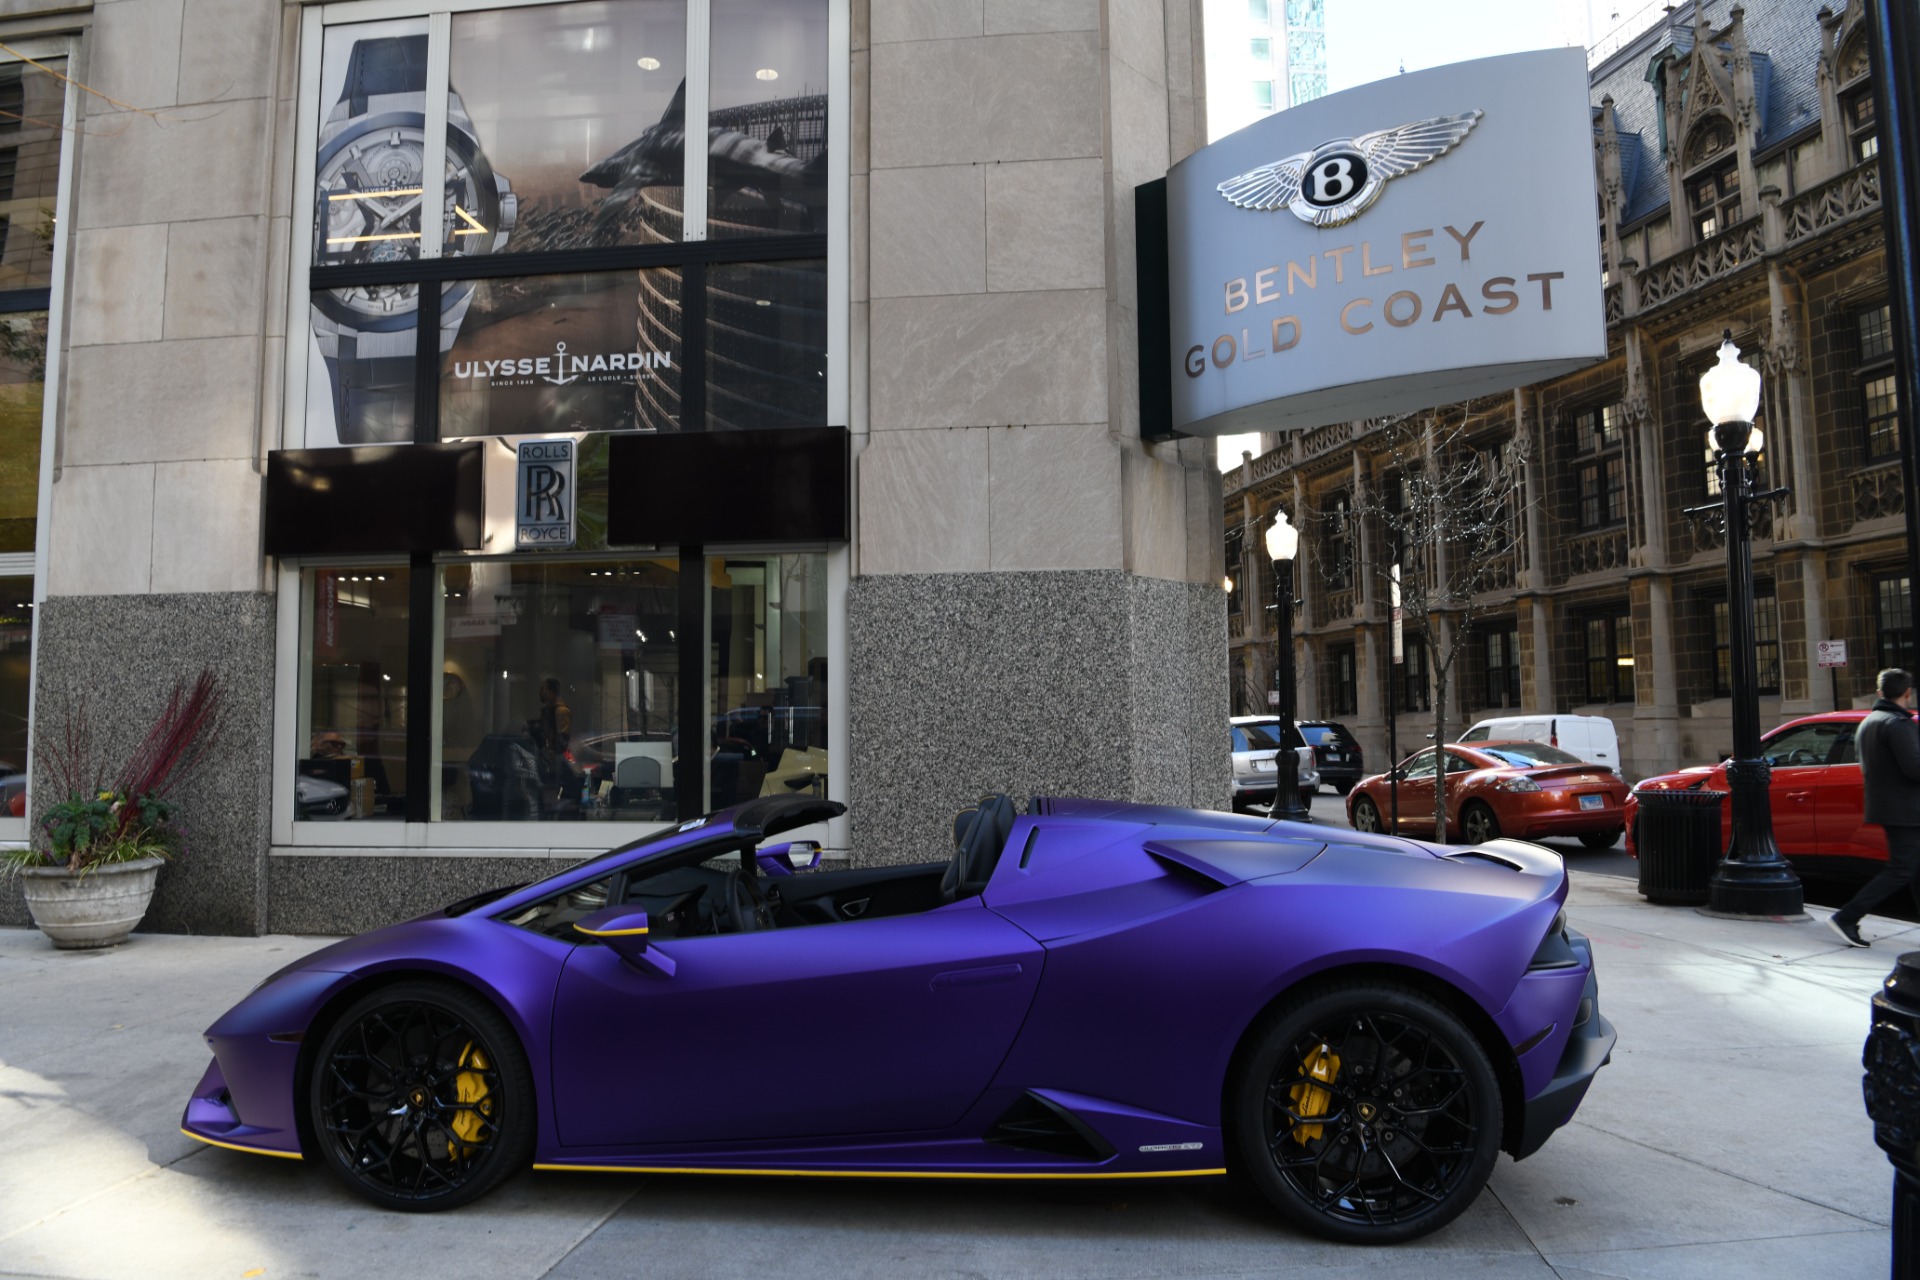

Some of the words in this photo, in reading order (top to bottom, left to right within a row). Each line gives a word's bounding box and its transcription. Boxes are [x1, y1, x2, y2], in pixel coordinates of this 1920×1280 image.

[1224, 220, 1486, 316] BENTLEY
[1184, 315, 1301, 379] GOLD
[1339, 271, 1565, 335] COAST
[454, 357, 551, 379] ULYSSE
[571, 351, 672, 373] NARDIN
[522, 445, 569, 459] ROLLS
[521, 527, 567, 540] ROYCE
